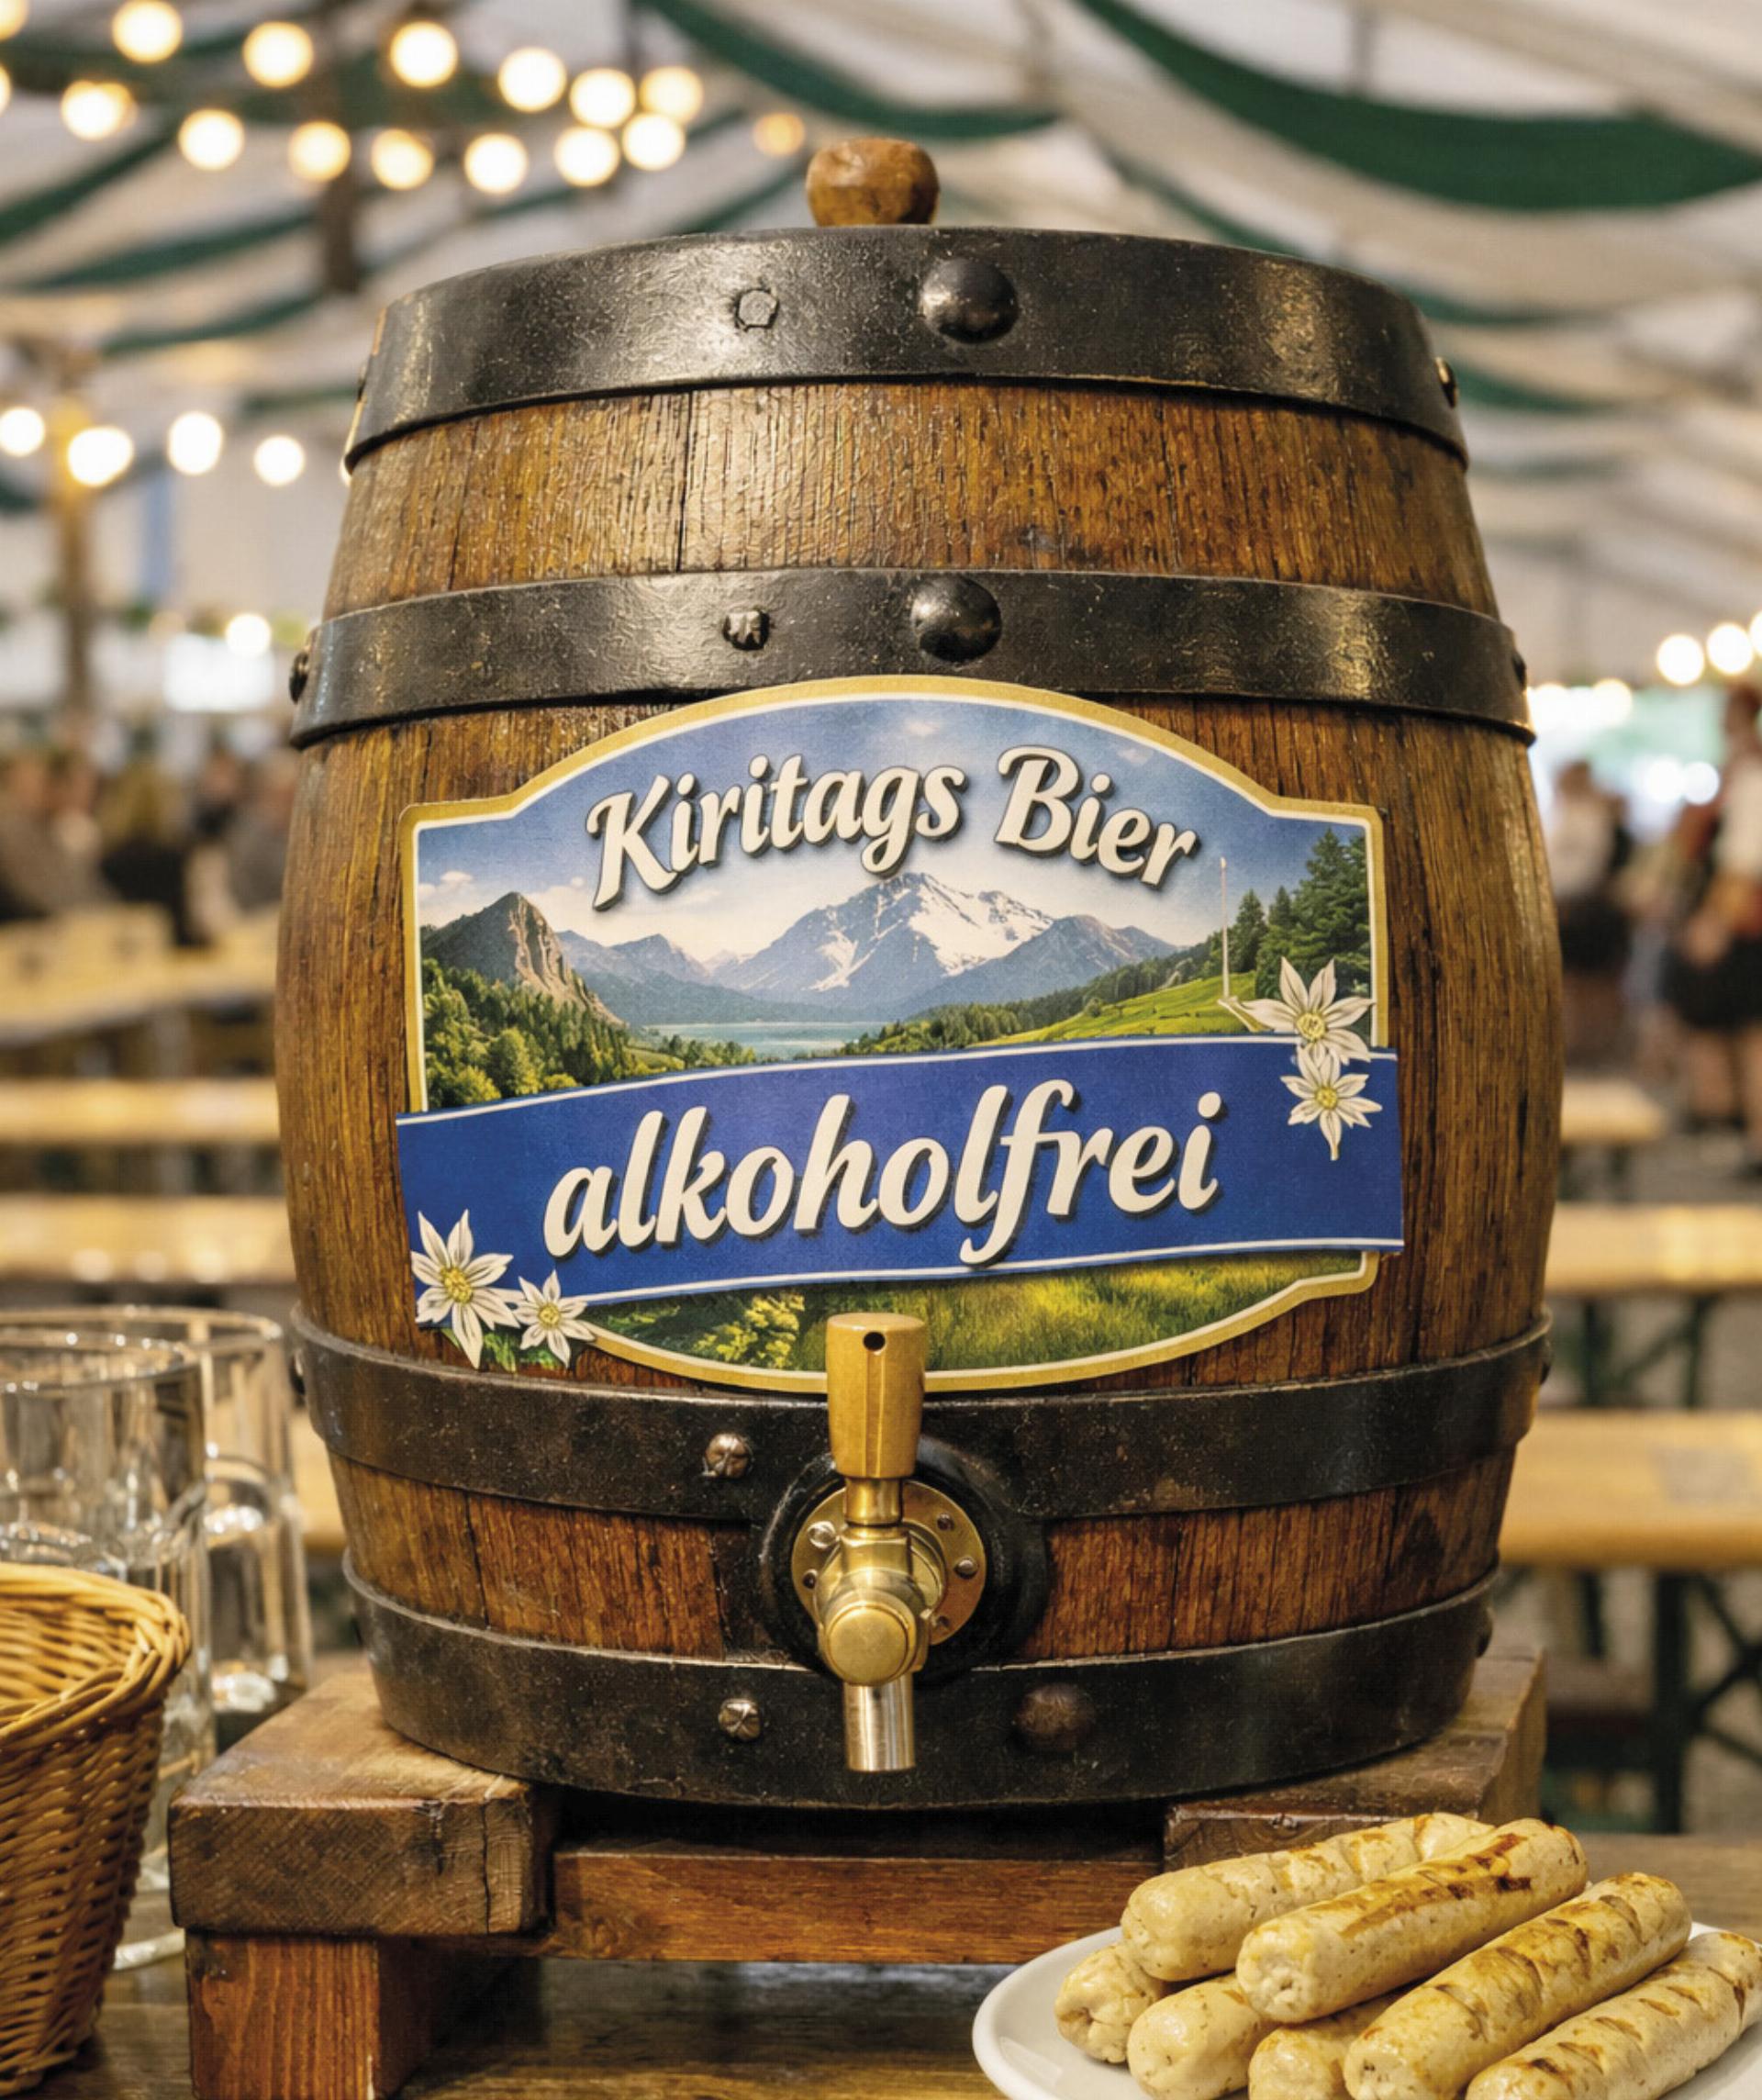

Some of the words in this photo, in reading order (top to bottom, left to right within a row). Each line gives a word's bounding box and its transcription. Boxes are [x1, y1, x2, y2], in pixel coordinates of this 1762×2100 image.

[586, 754, 965, 910] Kiritags
[995, 745, 1197, 888] Bier
[543, 1078, 1221, 1267] alkoholfrei
